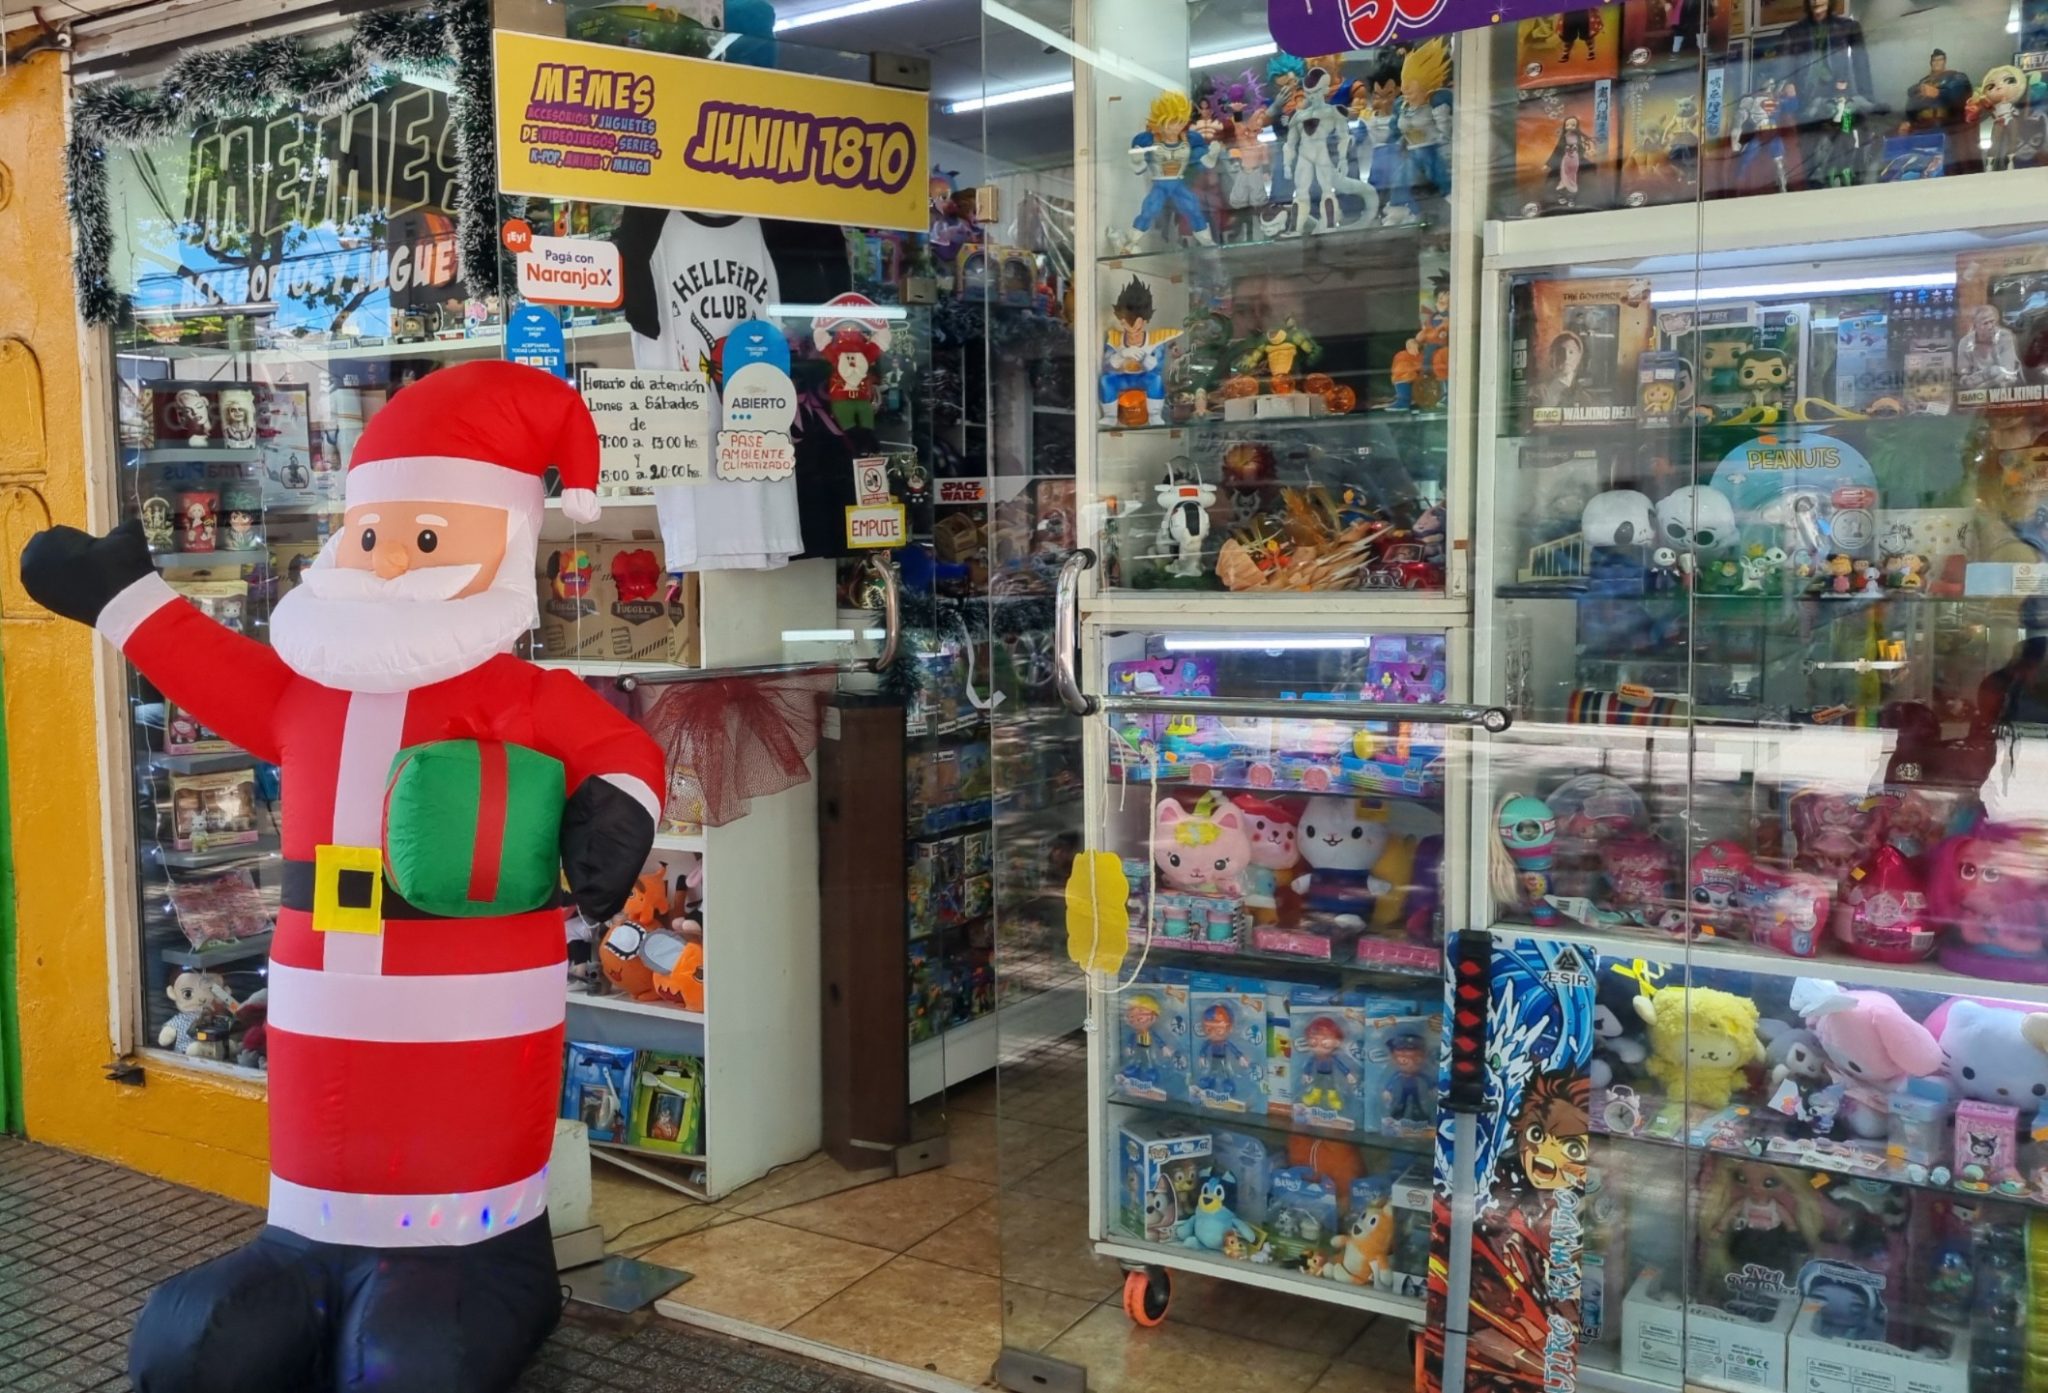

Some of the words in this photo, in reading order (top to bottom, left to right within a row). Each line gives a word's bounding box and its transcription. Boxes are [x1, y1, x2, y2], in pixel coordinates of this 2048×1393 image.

[532, 65, 654, 115] MEMES
[526, 106, 589, 126] ACCESORIOS
[590, 114, 598, 128] Y
[599, 115, 656, 136] JUGUETES
[520, 125, 539, 143] DE
[690, 108, 809, 175] JUNIN
[818, 124, 911, 186] 1810
[563, 152, 601, 170] ANIME
[602, 157, 611, 171] Y
[612, 157, 650, 175] MANGA
[355, 236, 468, 293] JUGUE
[545, 250, 572, 264] Pagá
[574, 255, 594, 264] con
[701, 296, 747, 319] CLUB
[583, 371, 626, 391] Horario
[630, 376, 645, 390] de
[649, 375, 705, 393] atención
[1989, 386, 2042, 402] WALKING
[588, 398, 623, 412] Lunes
[629, 402, 639, 411] a
[645, 395, 699, 411] Sábados
[731, 398, 786, 409] ABIERTO
[1563, 406, 1610, 420] WALKING
[629, 417, 646, 431] de
[731, 434, 763, 448] PASE
[721, 448, 785, 460] AMBIENTE
[1747, 447, 1840, 470] PEANUTS
[650, 464, 684, 480] 20:00
[723, 460, 790, 471] CLIMATIZADO
[942, 481, 980, 491] SPACE
[852, 517, 899, 537] EMPUJE
[1548, 1188, 1582, 1300] KAMADO
